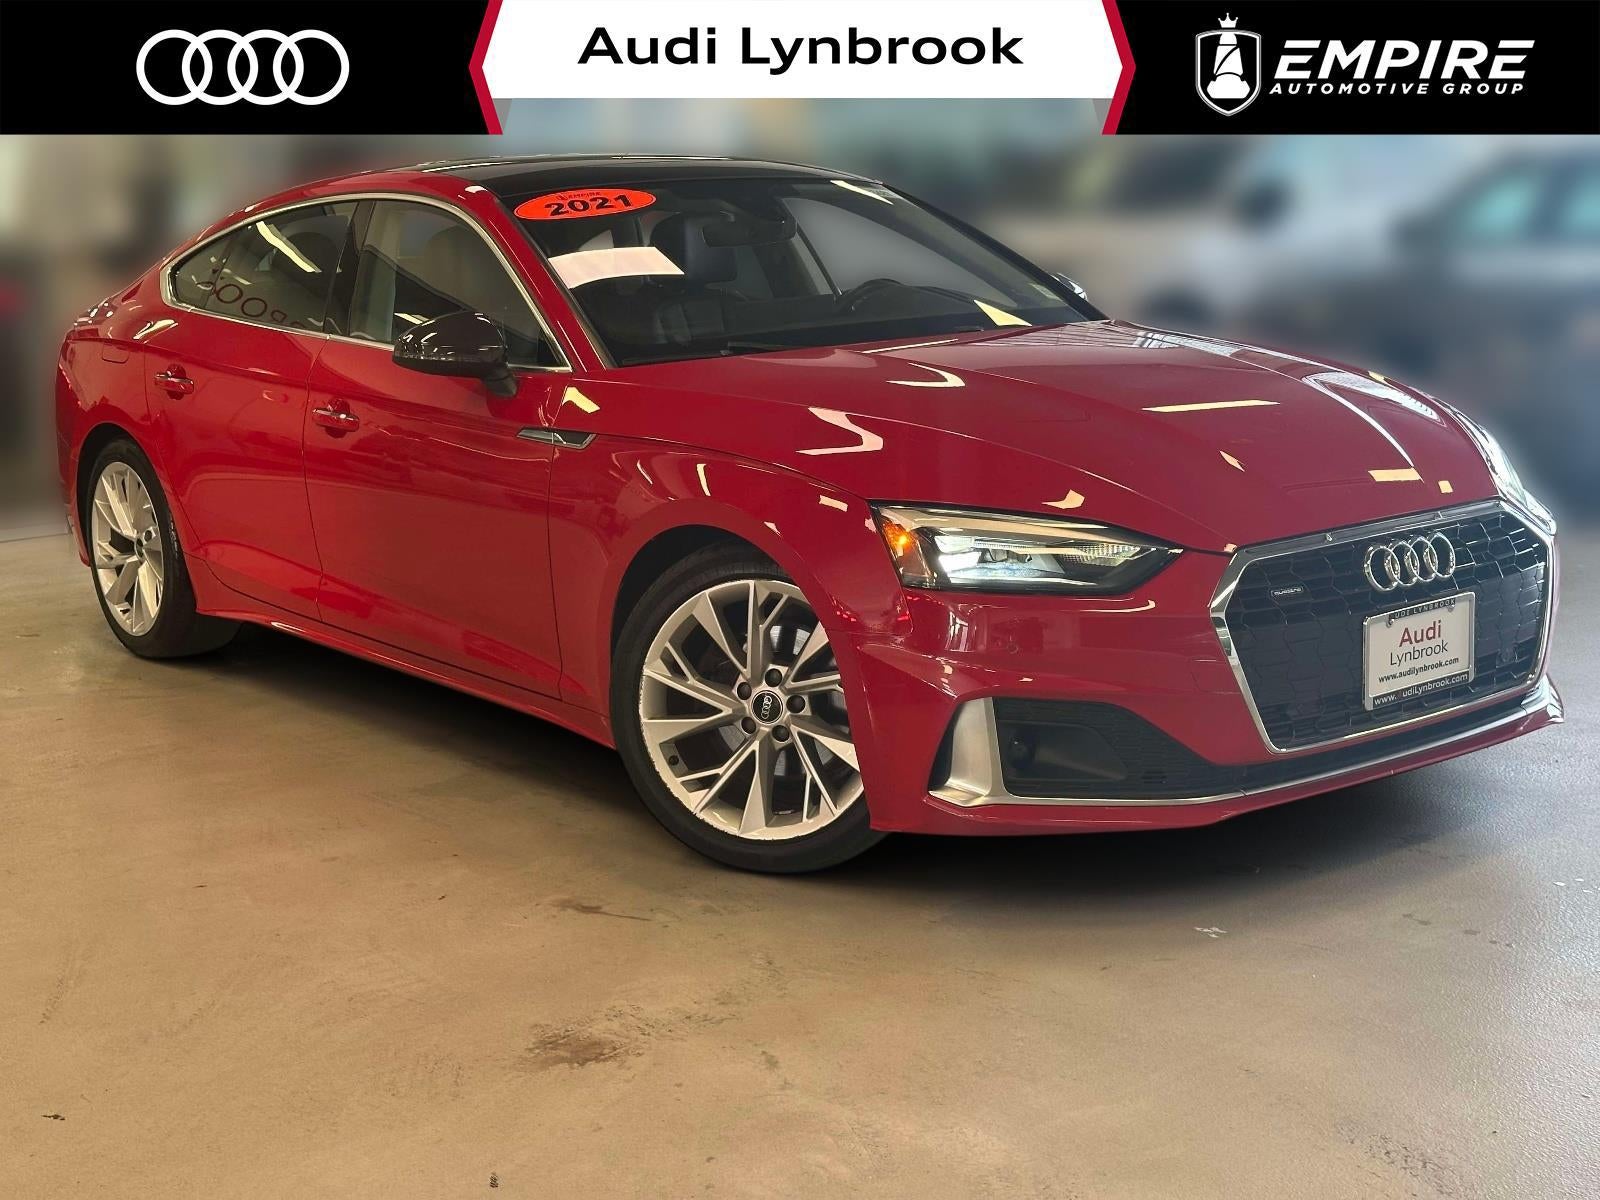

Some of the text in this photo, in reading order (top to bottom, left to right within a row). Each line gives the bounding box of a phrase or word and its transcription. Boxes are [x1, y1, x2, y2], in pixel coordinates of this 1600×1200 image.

[544, 194, 632, 216] 2021
[1399, 620, 1442, 647] Audi
[1390, 639, 1449, 667] Lynbrook
[1378, 656, 1460, 683] www.audilynbrook.com
[1374, 673, 1469, 705] www.udiLynbrook.com
